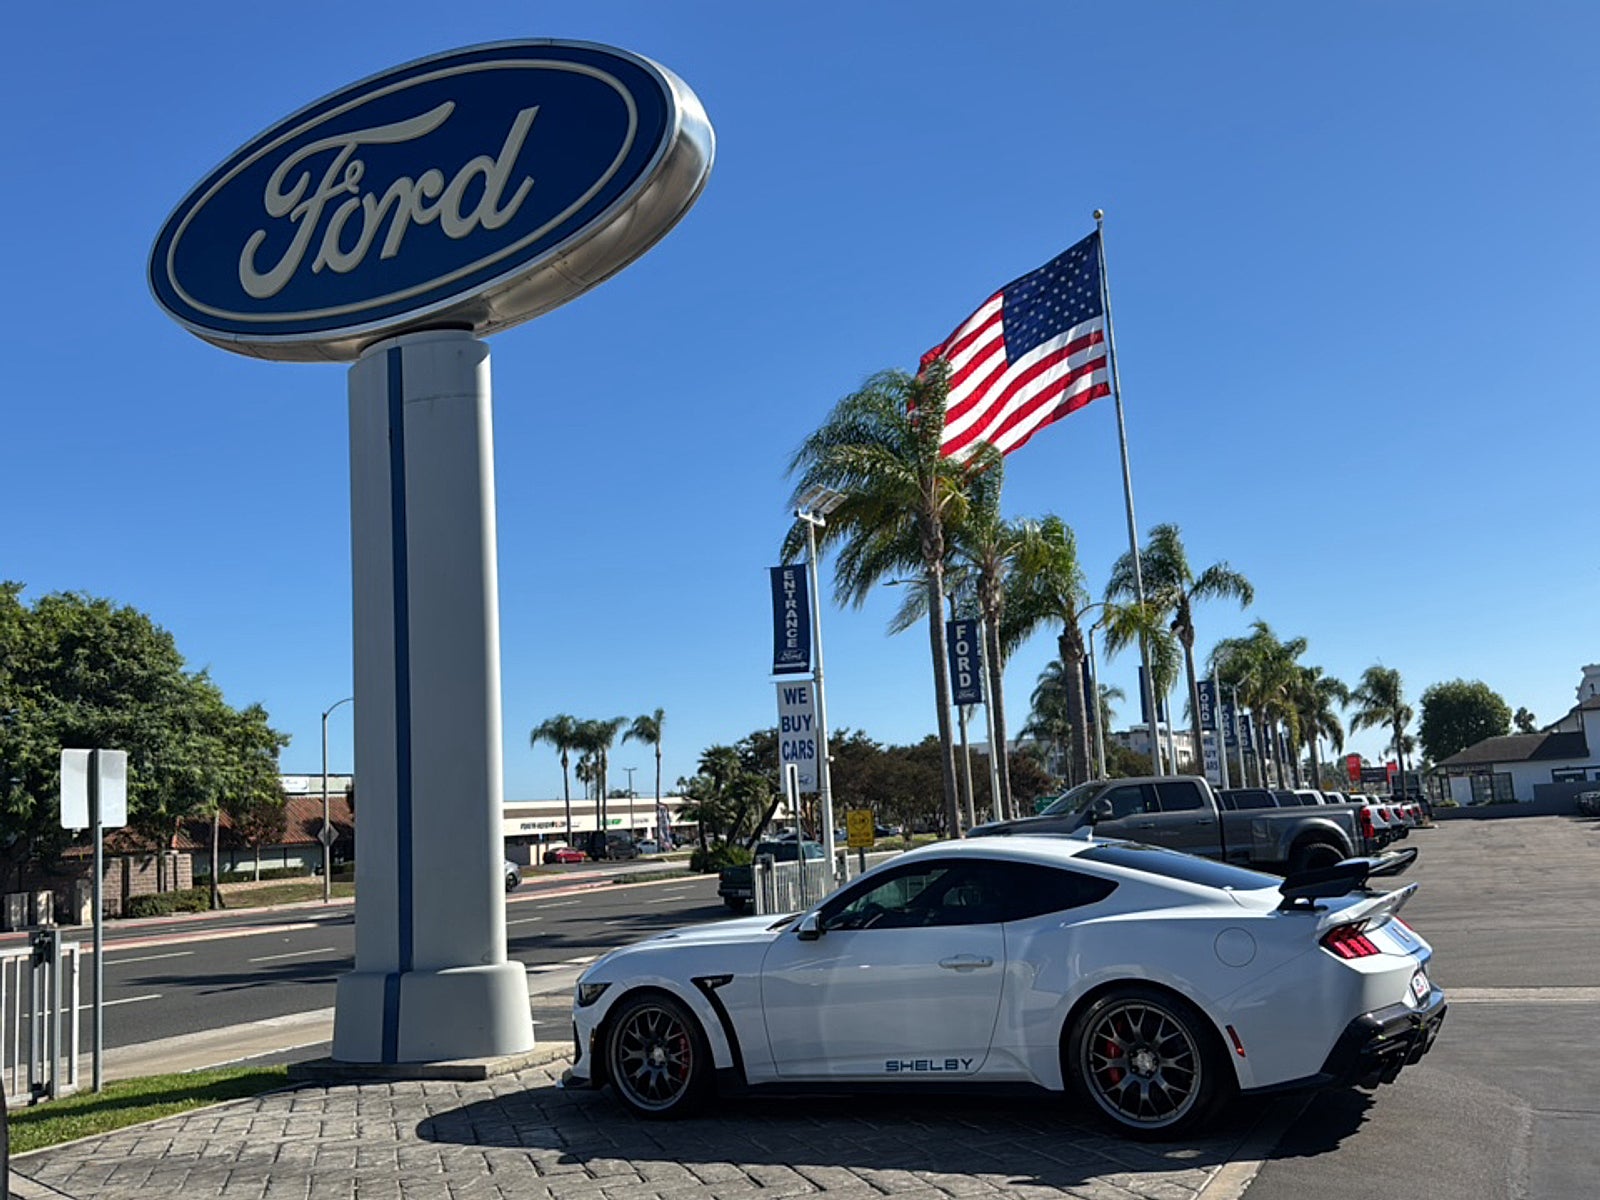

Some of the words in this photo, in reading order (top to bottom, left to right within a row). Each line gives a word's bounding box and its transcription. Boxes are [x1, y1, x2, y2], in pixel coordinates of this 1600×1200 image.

[238, 100, 540, 299] Ford
[783, 569, 797, 648] ENTRANCE
[956, 625, 971, 688] FORD
[783, 687, 808, 705] WE
[1200, 684, 1210, 720] FORD
[781, 714, 812, 733] BUY
[782, 739, 814, 760] CARS
[885, 1058, 973, 1071] SHELBY
